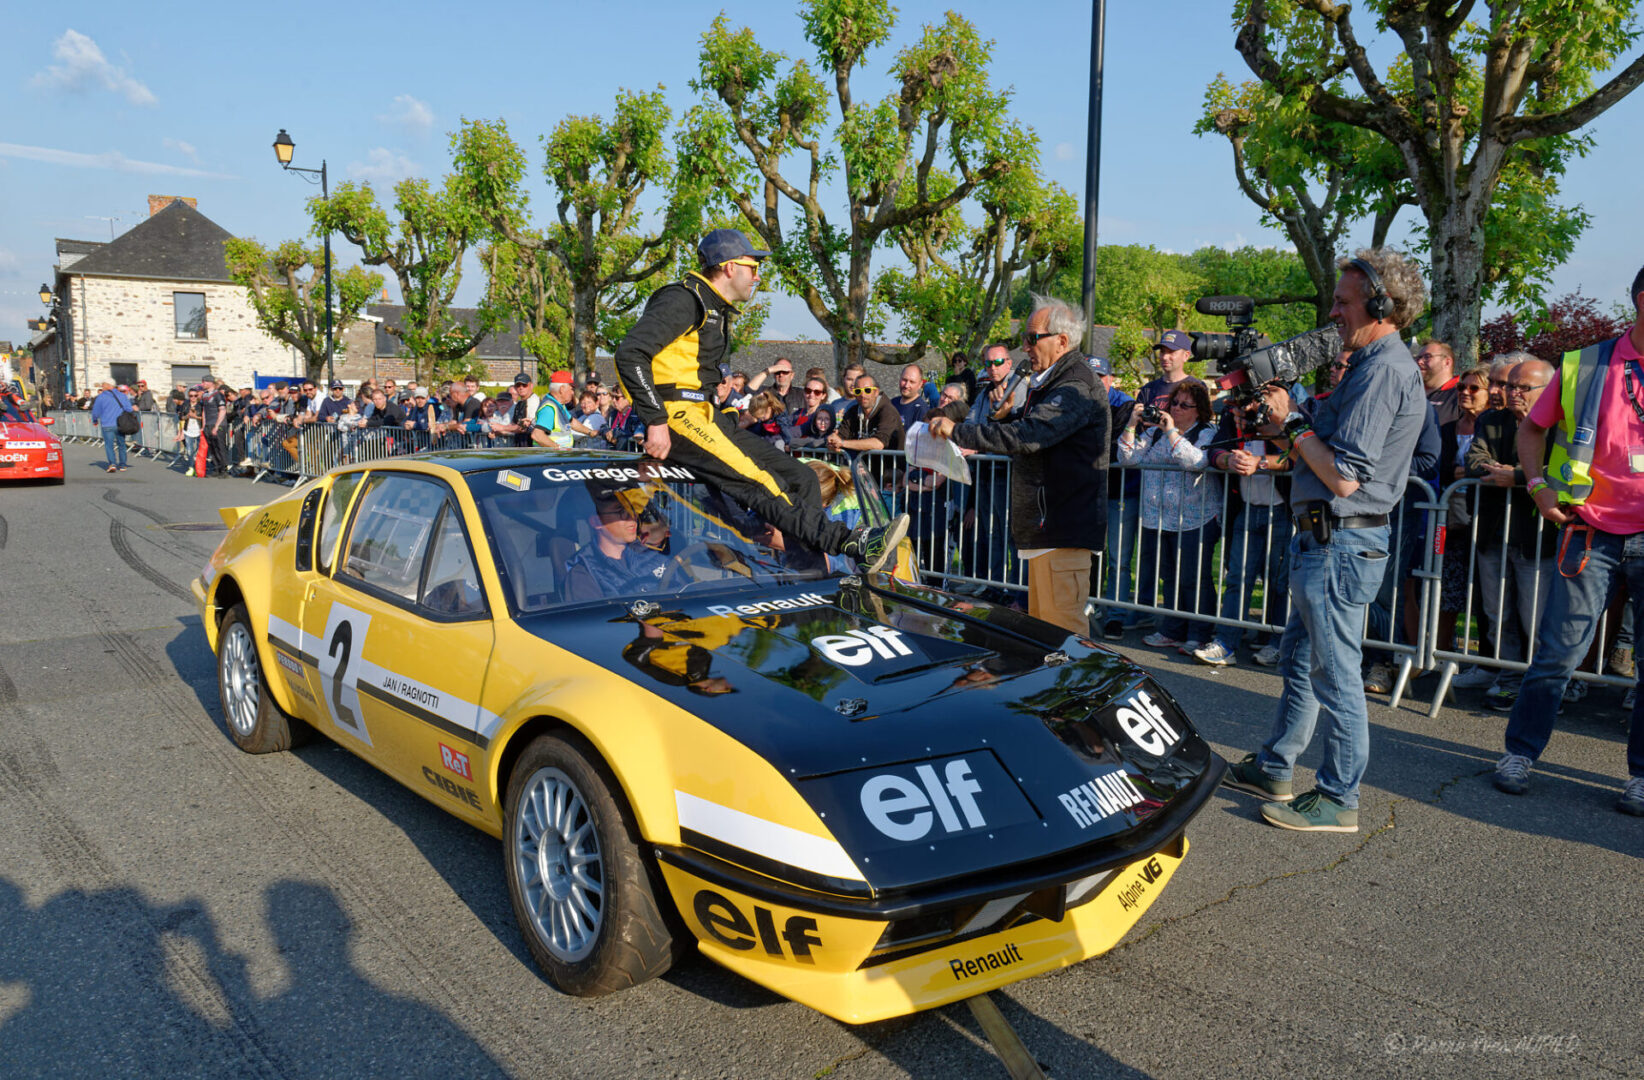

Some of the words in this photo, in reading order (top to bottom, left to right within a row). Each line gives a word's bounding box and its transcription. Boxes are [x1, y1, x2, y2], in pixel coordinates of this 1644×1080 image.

[542, 467, 641, 482] Garage
[646, 465, 696, 480] JAN
[254, 512, 291, 542] Renault
[706, 593, 835, 619] Renault
[811, 625, 914, 667] elf
[328, 619, 358, 730] 2
[383, 676, 398, 693] JAN
[401, 683, 440, 709] RAGNOTTI
[1116, 690, 1181, 757] elf
[860, 759, 987, 842] elf
[1057, 768, 1146, 829] RENAULT
[1117, 880, 1146, 912] Alpine
[1137, 856, 1164, 885] V6
[693, 889, 823, 964] elf
[949, 943, 1024, 982] Renault
